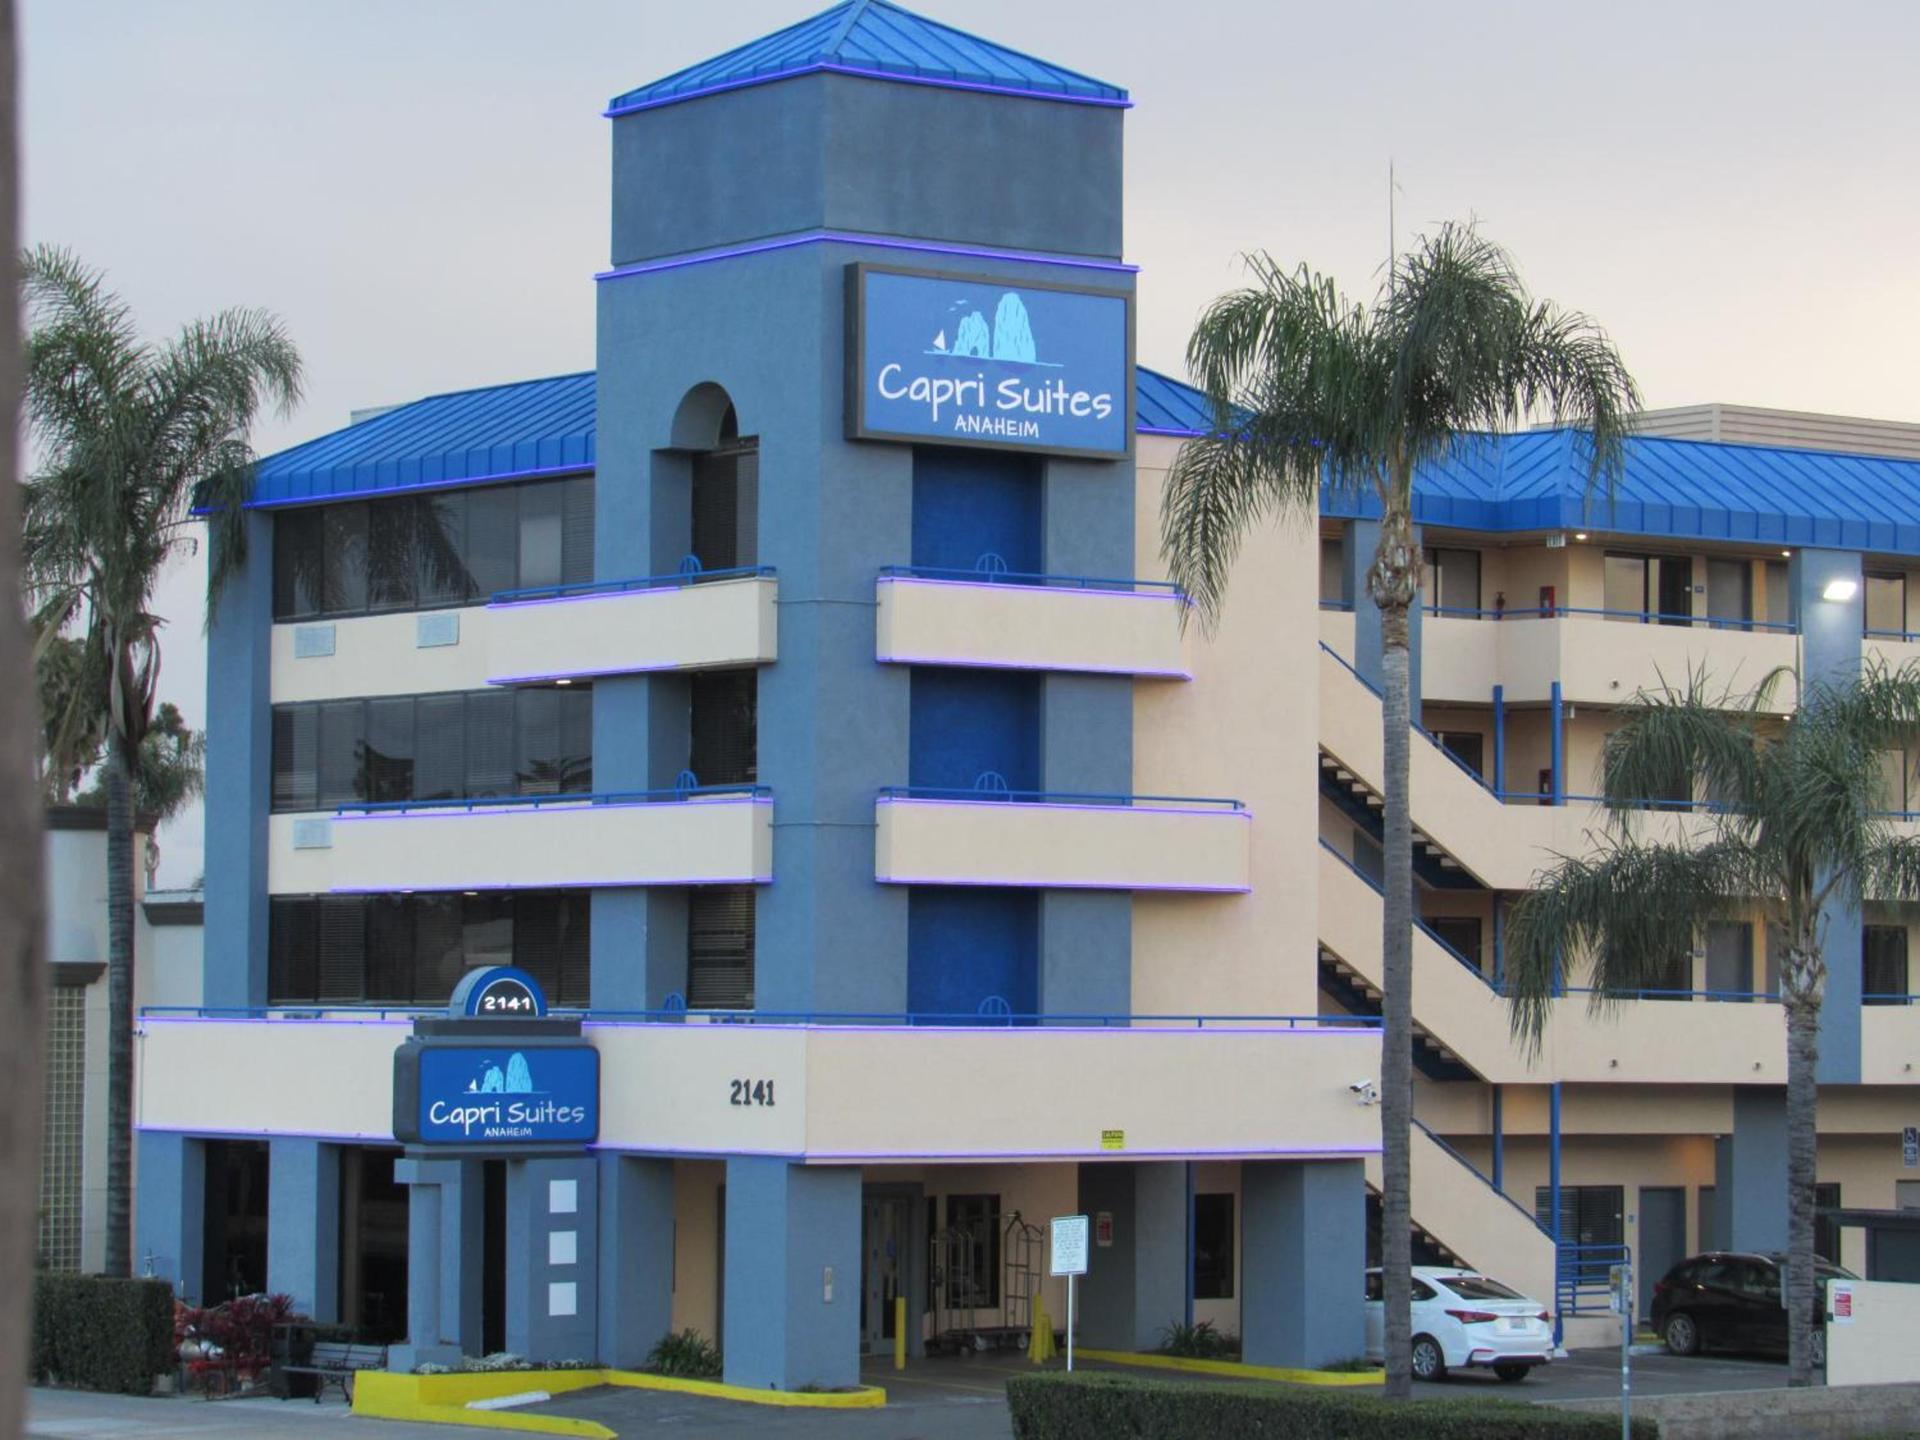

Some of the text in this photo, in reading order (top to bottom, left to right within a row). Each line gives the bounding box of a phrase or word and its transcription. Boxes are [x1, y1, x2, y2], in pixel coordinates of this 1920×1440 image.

[878, 364, 1112, 422] Capri Suites
[954, 414, 1039, 438] ANAHEIM
[484, 996, 531, 1010] 2141
[730, 1079, 775, 1106] 2141
[429, 1100, 585, 1136] Capri Suites
[484, 1127, 532, 1137] ANAHEIM
